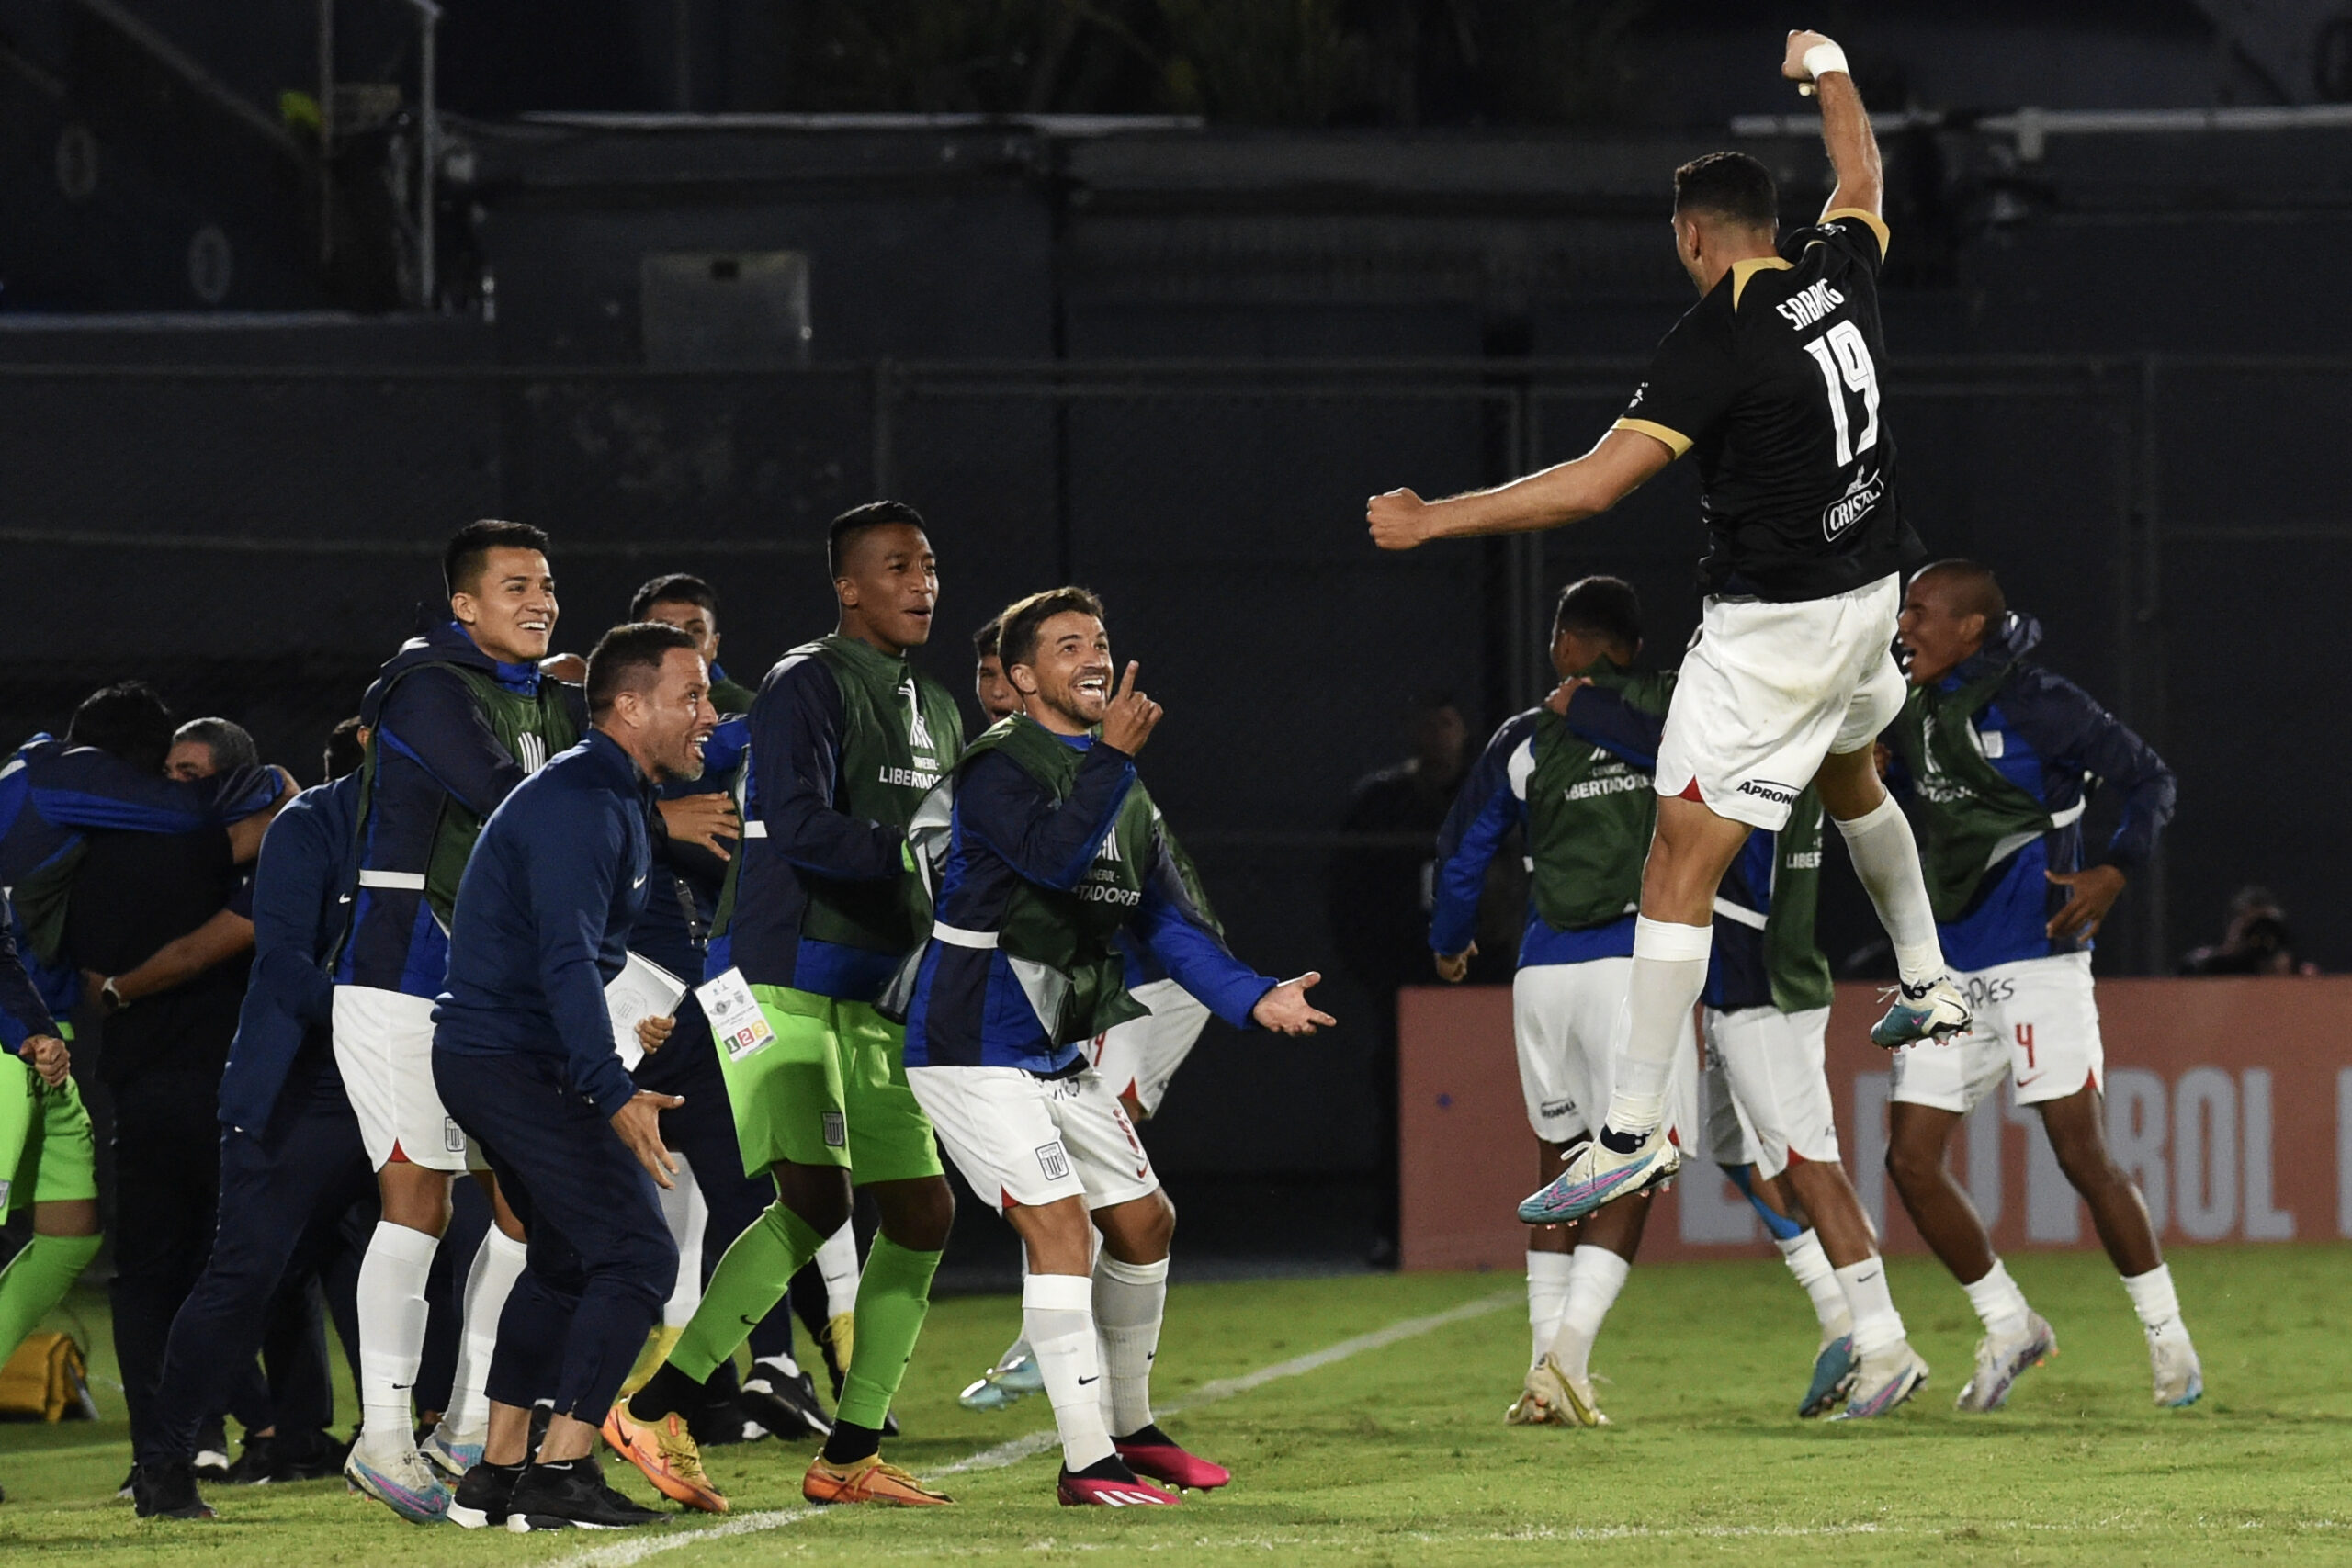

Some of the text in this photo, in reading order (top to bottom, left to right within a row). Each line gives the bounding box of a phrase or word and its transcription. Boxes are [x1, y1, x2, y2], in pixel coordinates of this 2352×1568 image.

[1803, 319, 1881, 468] 19
[1736, 780, 1796, 805] APRON
[2015, 1022, 2036, 1069] 4
